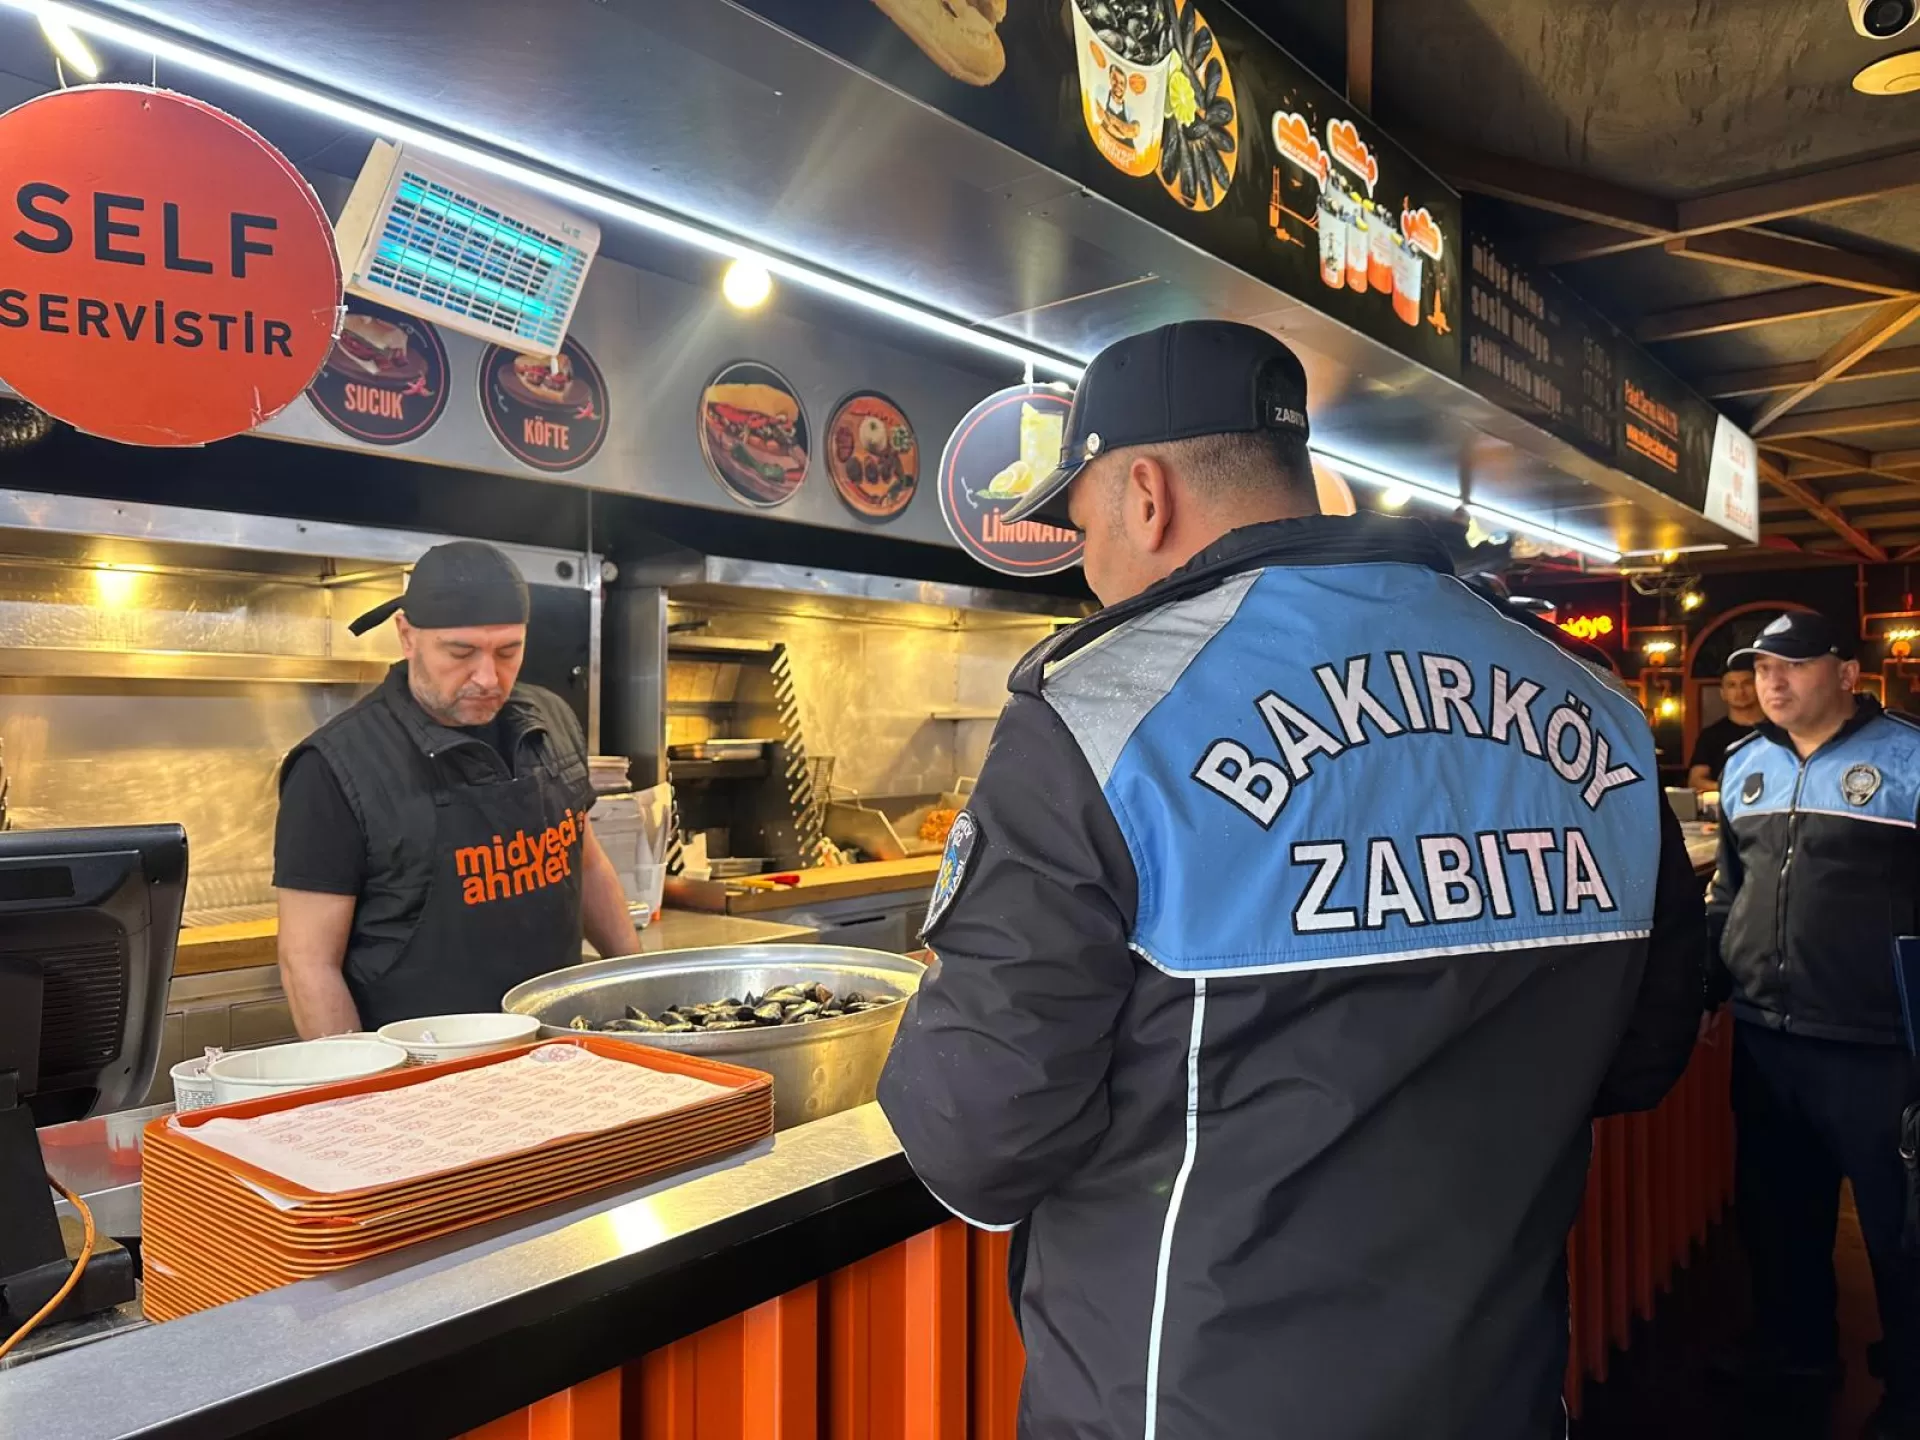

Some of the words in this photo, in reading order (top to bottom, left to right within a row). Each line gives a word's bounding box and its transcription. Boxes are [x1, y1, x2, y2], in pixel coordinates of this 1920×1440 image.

[13, 182, 278, 278] SELF
[0, 289, 293, 357] SERVİSTİR
[344, 383, 404, 420] SUCUK
[523, 416, 570, 451] KÖFTE
[1190, 651, 1644, 831] BAKIRKÖY
[455, 808, 577, 877] midyeci
[463, 846, 571, 905] ahmet
[1290, 827, 1618, 935] ZABITA
